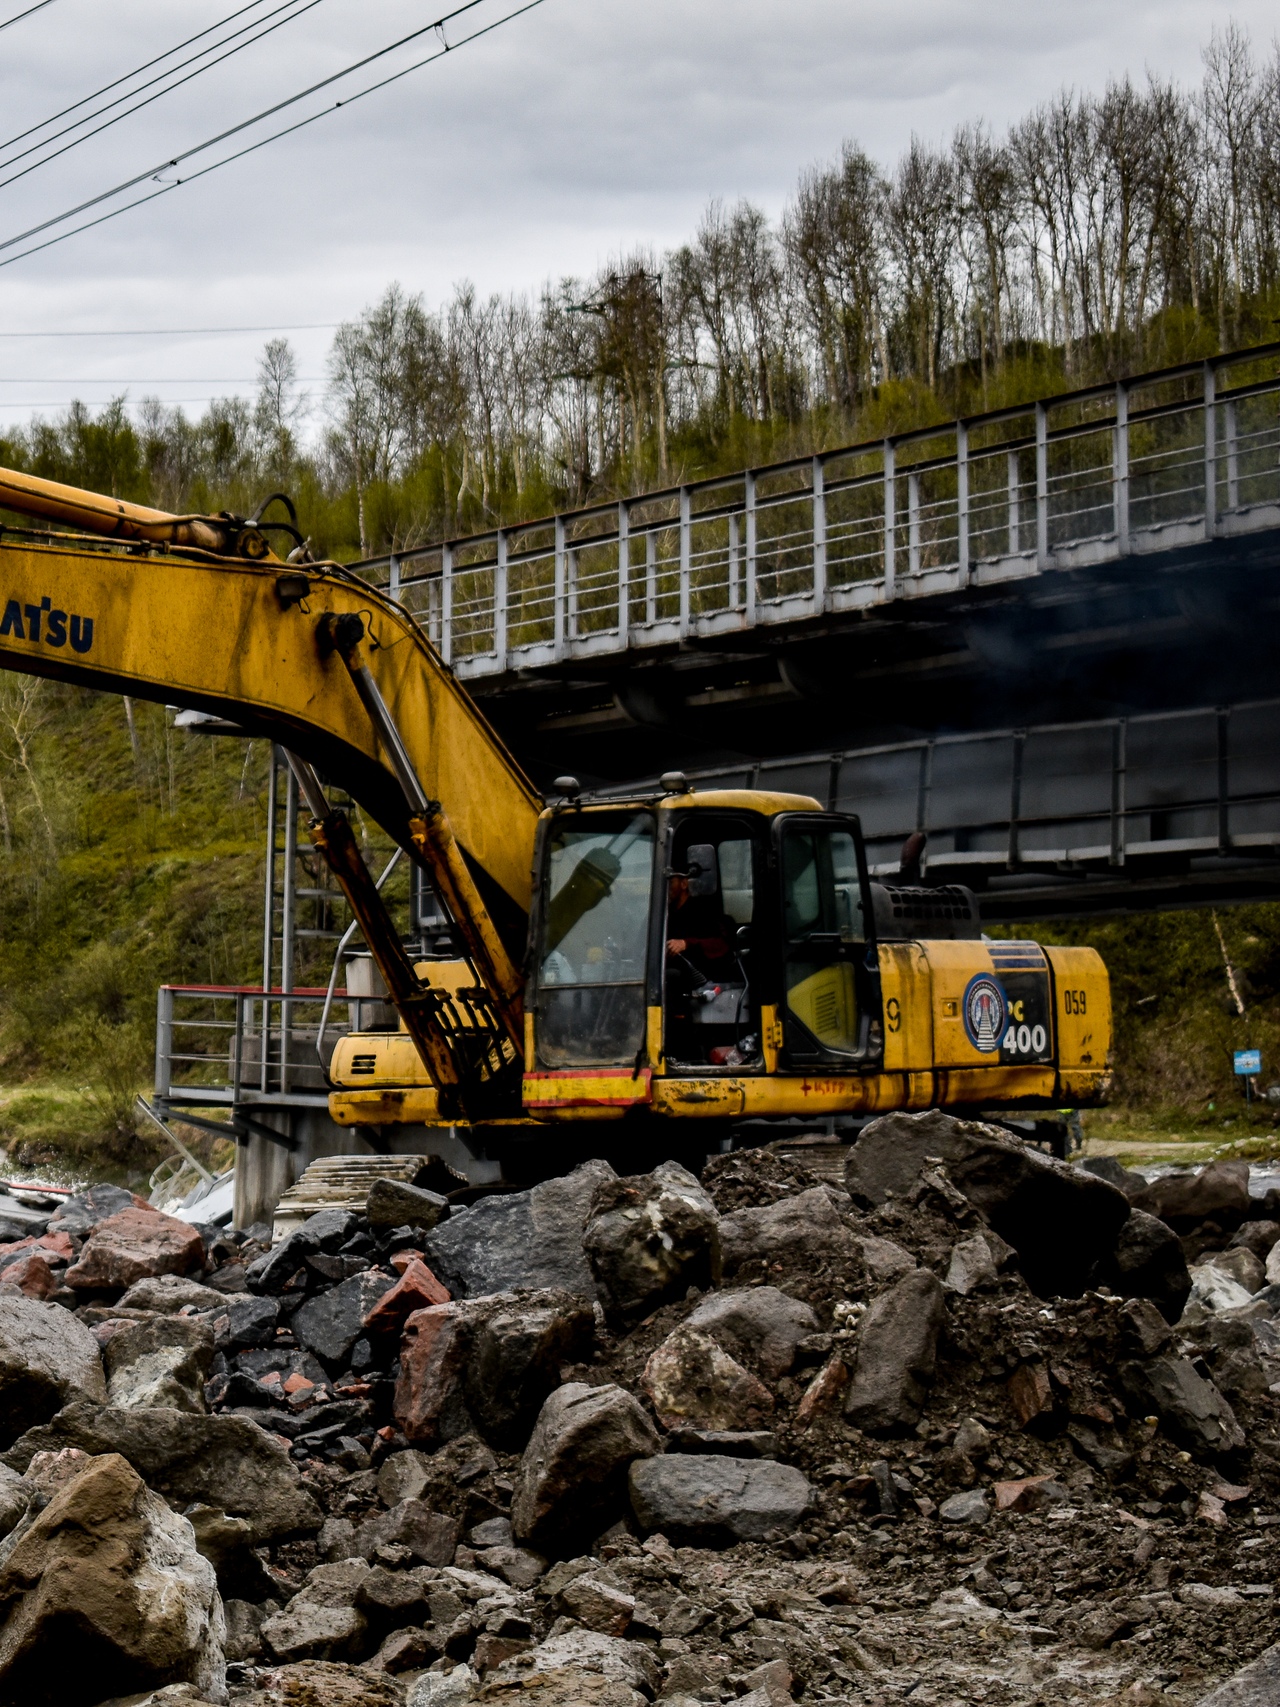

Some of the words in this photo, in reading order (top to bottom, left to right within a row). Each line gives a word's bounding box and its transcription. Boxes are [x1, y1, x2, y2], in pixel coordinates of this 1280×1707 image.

[886, 997, 901, 1033] 9
[1064, 990, 1087, 1015] 059
[1003, 1024, 1047, 1054] 400
